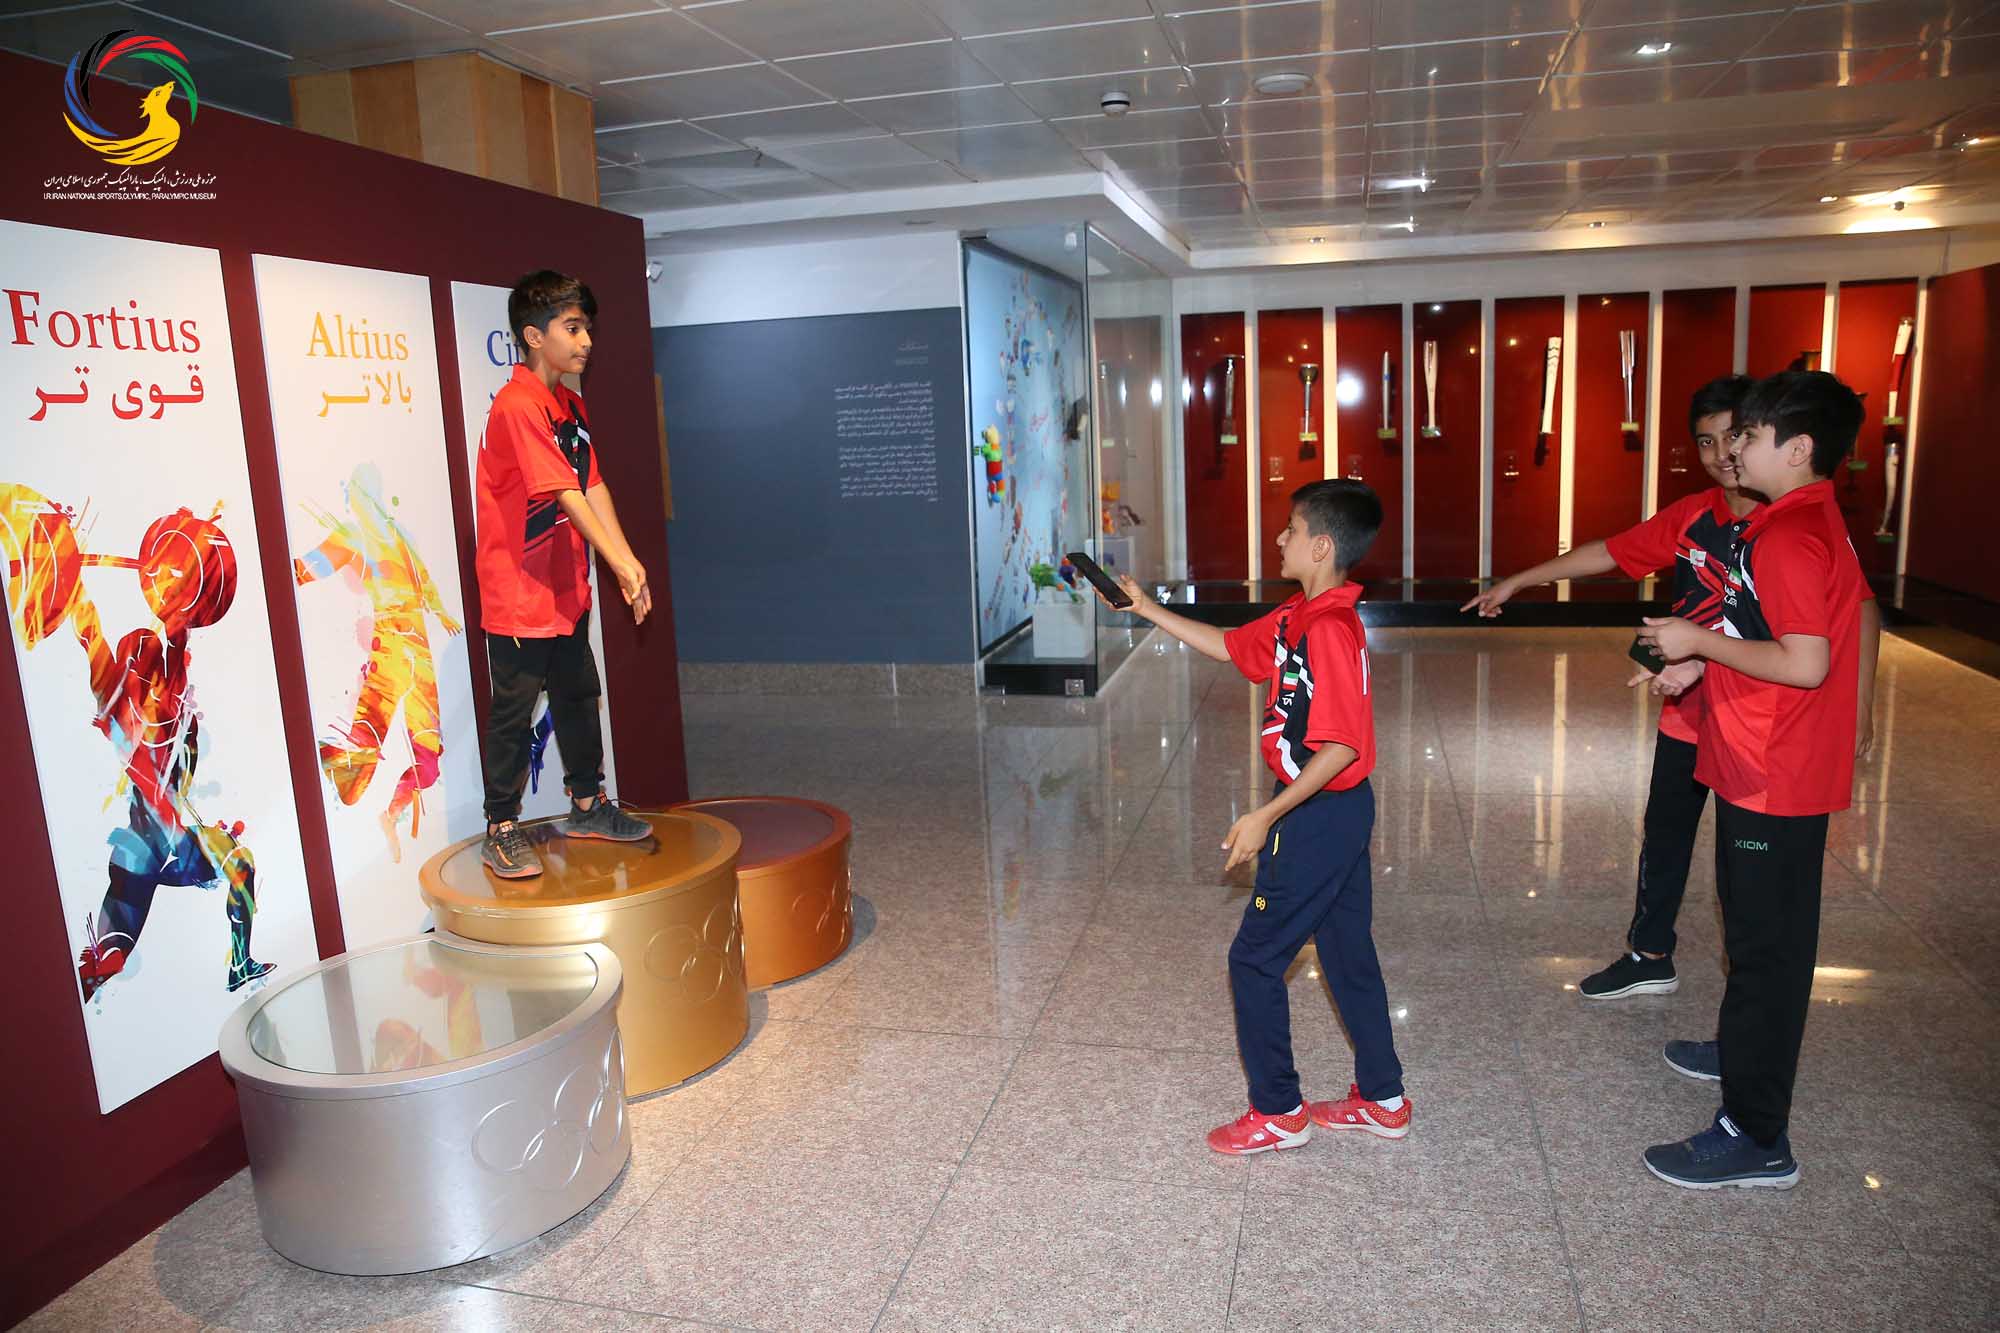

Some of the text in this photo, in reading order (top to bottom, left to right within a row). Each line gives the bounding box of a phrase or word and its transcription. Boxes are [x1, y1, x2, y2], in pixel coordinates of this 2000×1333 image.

[2, 288, 201, 353] Fortius
[306, 311, 409, 360] Altius
[28, 363, 205, 422] قوی تر
[317, 370, 413, 418] بالاتر
[1734, 839, 1769, 852] XIOM
